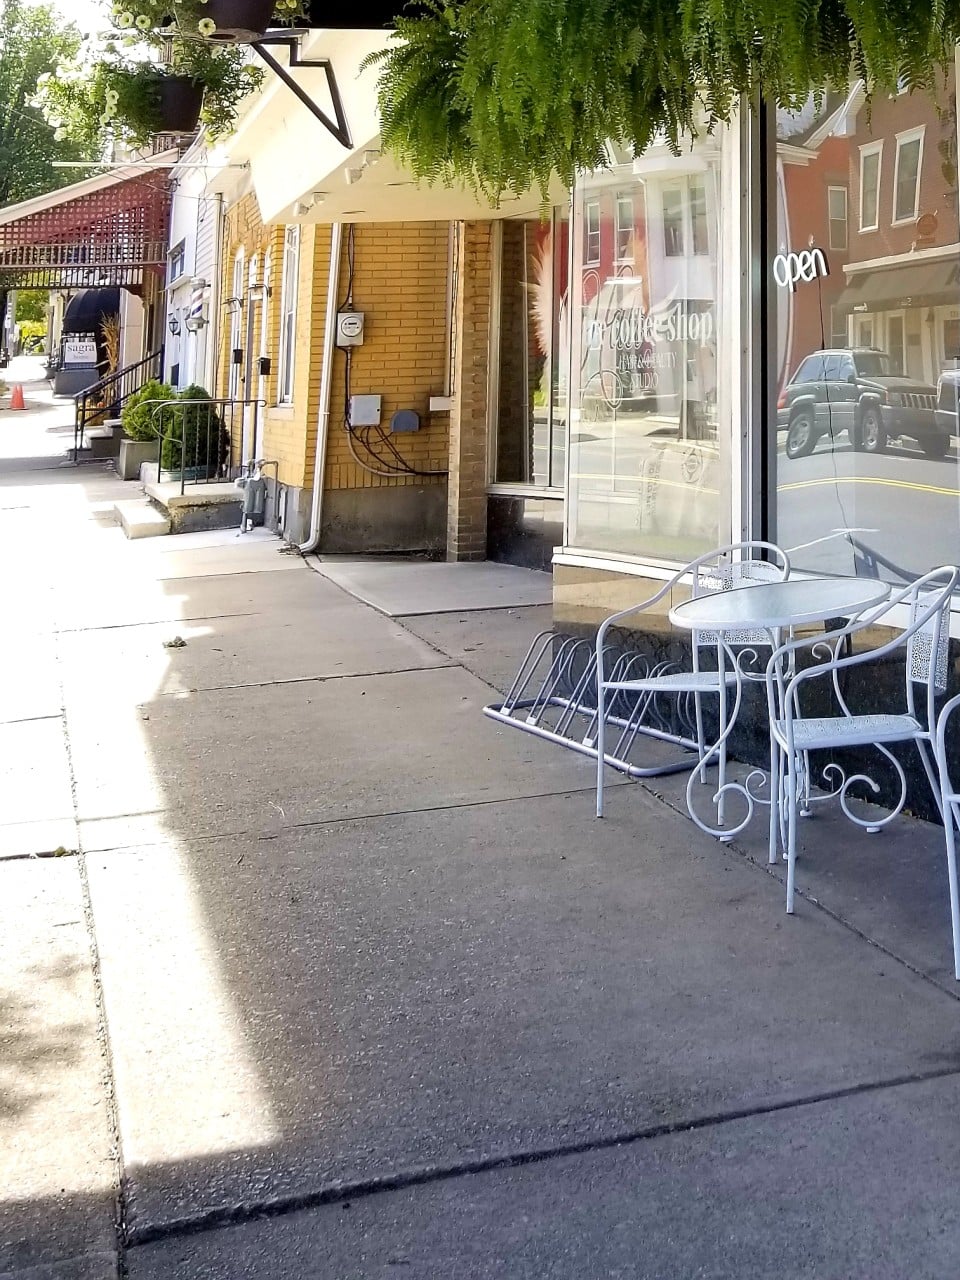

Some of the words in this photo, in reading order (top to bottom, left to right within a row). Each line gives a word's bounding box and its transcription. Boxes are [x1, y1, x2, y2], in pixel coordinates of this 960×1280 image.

[773, 248, 828, 293] open
[667, 302, 713, 348] shop
[67, 344, 95, 355] sagra
